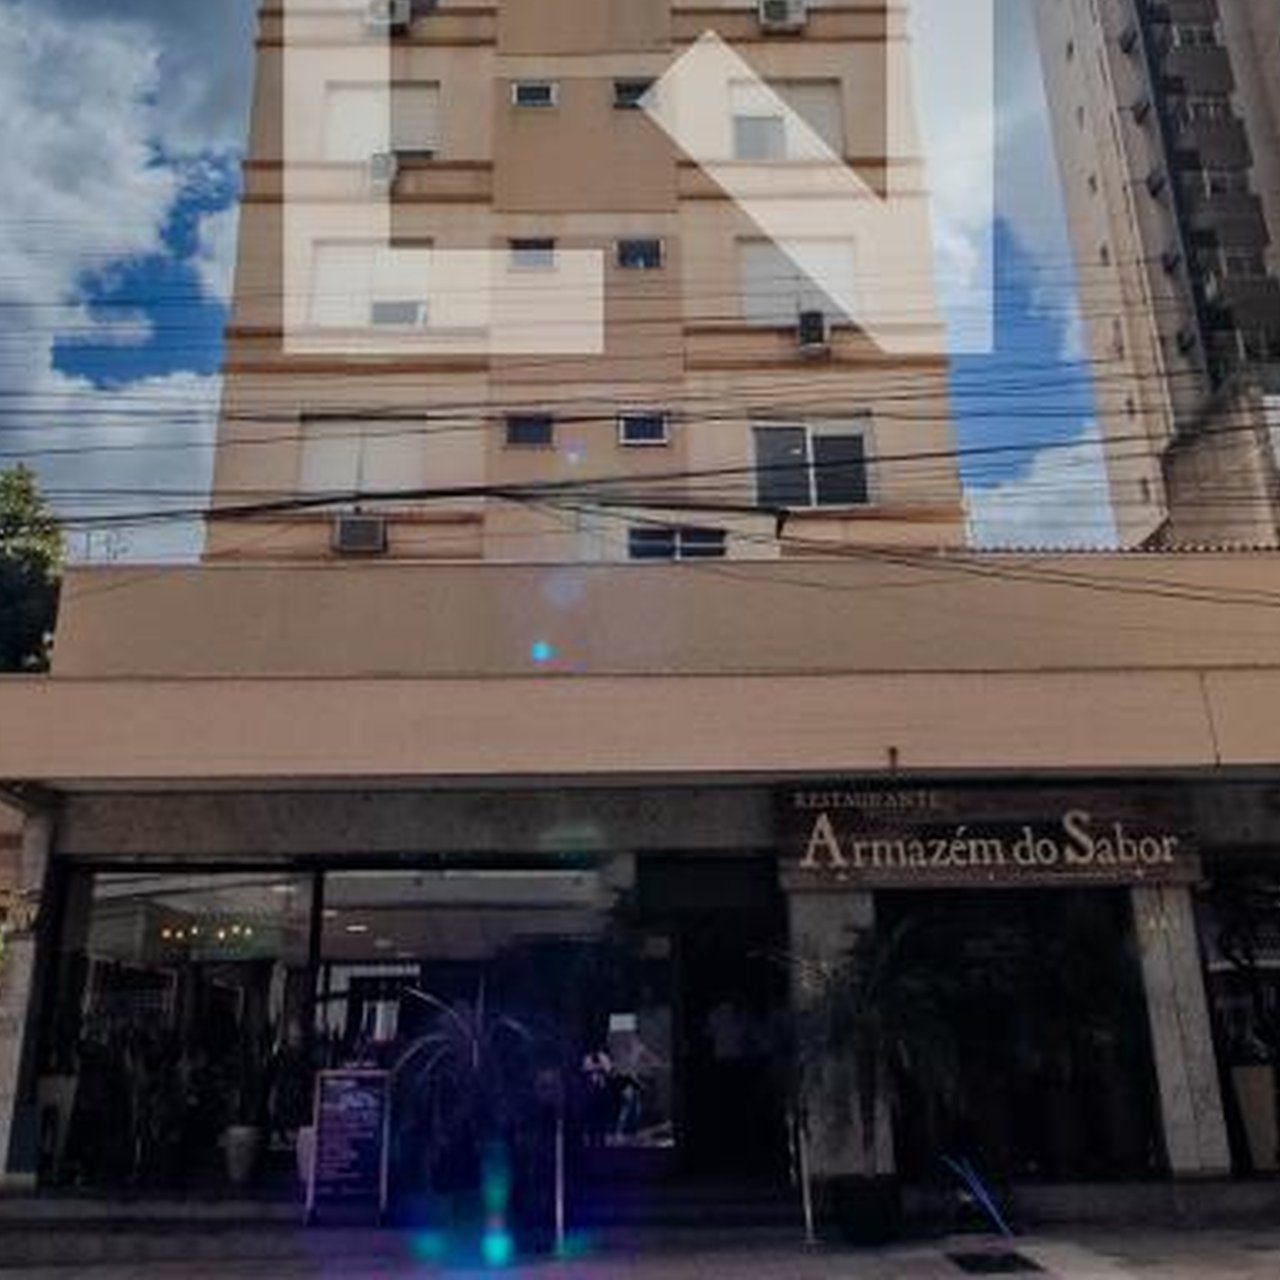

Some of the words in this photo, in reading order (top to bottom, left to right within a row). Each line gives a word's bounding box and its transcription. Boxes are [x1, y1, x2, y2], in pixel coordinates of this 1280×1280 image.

[799, 812, 1006, 868] Armazém
[1013, 825, 1058, 865] do
[1063, 809, 1179, 865] Sabor
